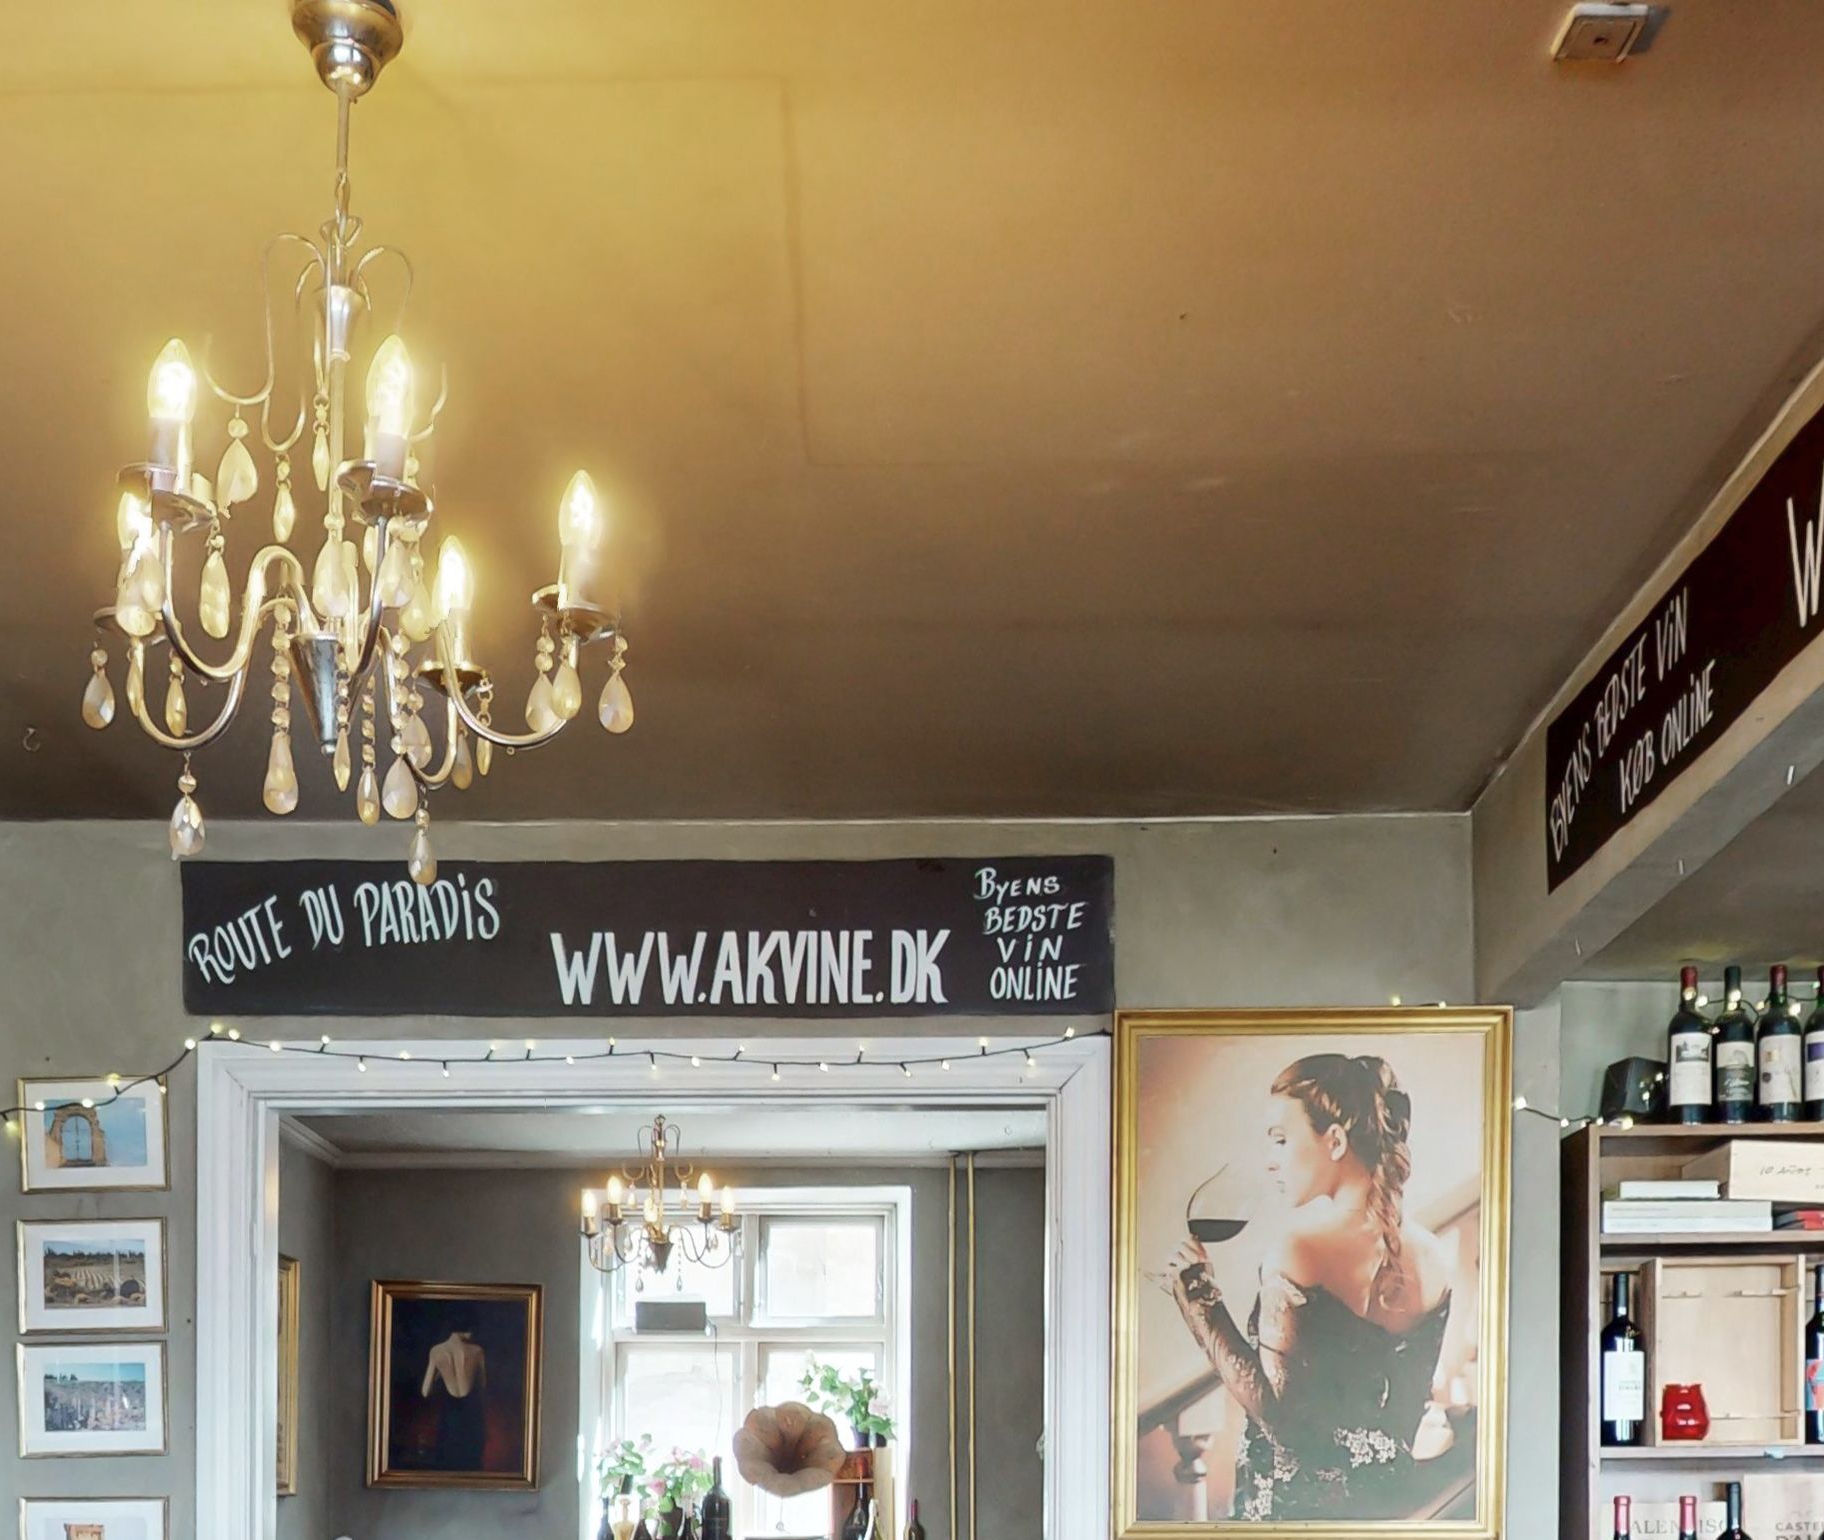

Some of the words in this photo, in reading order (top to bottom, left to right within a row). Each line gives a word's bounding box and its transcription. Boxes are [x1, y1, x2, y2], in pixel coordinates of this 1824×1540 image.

[188, 894, 292, 985] ROUTE
[298, 884, 345, 951] DU
[982, 901, 1088, 935] BEDSTE
[549, 929, 952, 1005] WWW.AKVINE.DK
